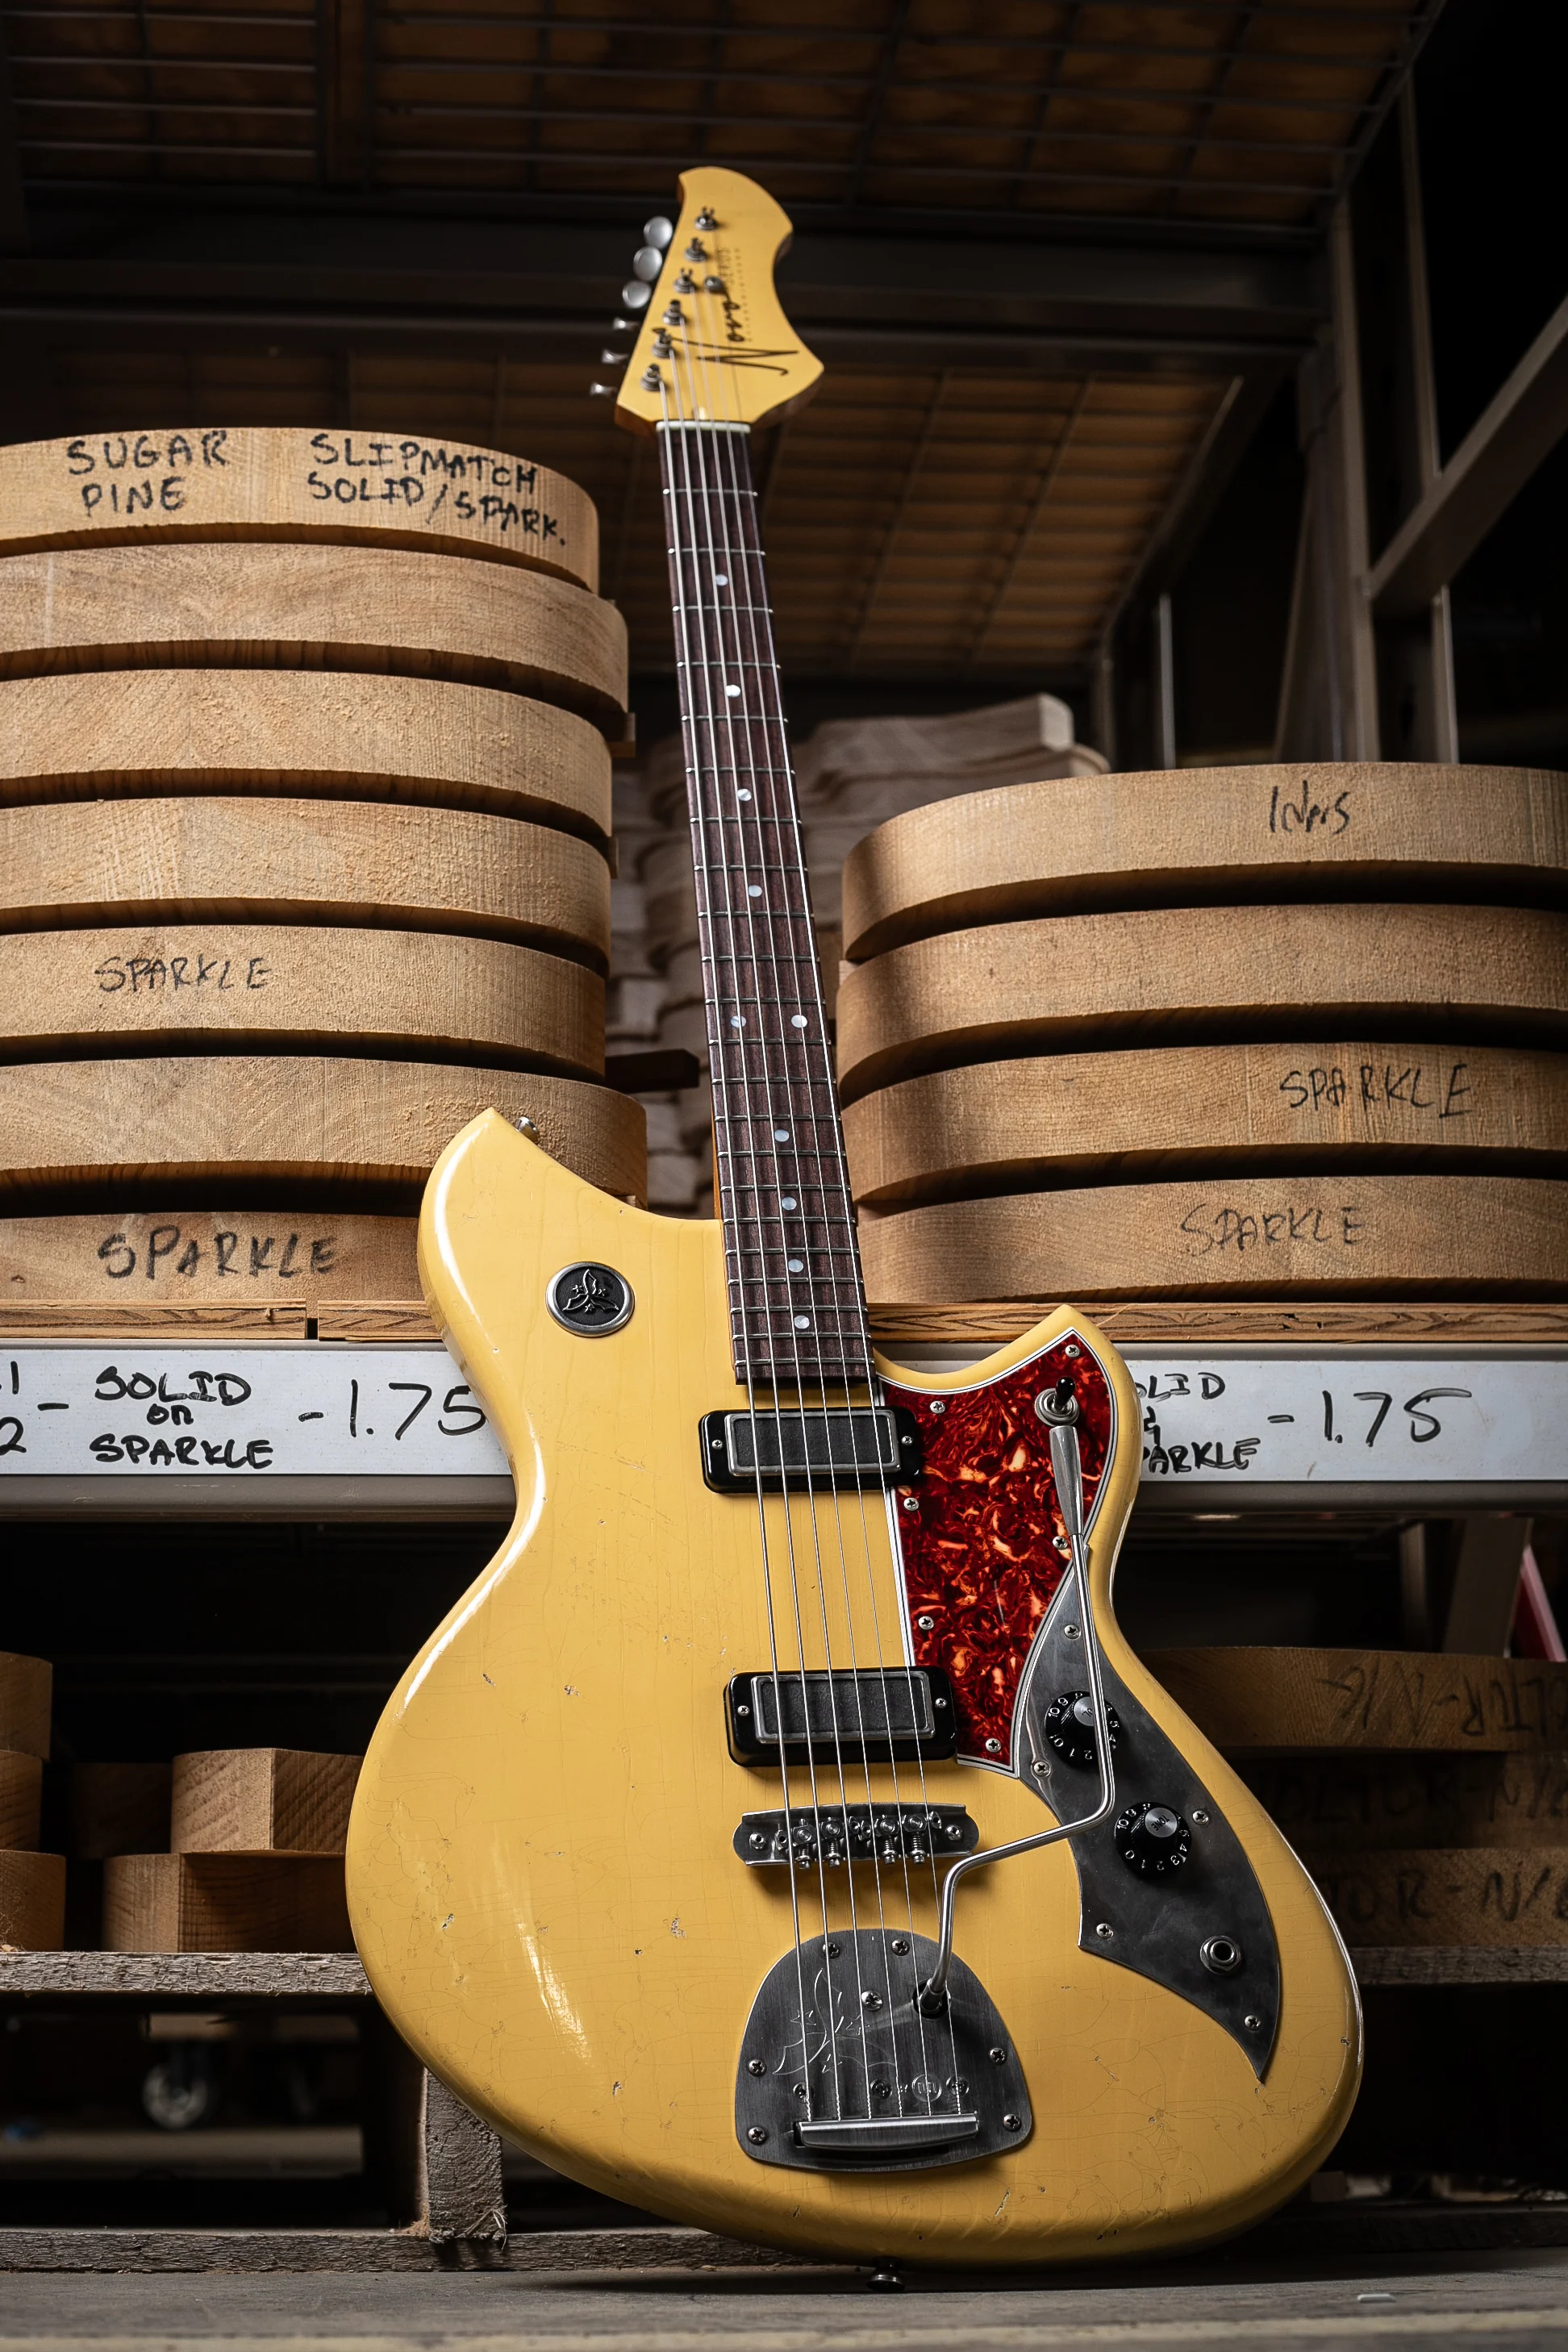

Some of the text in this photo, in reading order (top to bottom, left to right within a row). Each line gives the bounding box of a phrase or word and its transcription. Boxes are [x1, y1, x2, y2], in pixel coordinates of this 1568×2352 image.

[67, 430, 227, 475] SUGAR
[311, 433, 536, 494] SLIPMATCH
[82, 477, 186, 517] PINE
[94, 954, 272, 992] SPARKLE
[1280, 1063, 1474, 1119] SPARKLE
[1181, 1203, 1366, 1257] SPARKLE
[98, 1224, 339, 1281] SPARKLE
[0, 1361, 19, 1395] 1
[94, 1366, 252, 1406] SOLID
[89, 1432, 273, 1470] SPARKLE
[1048, 1707, 1061, 1718] 10
[1057, 1697, 1069, 1706] 9
[1150, 1814, 1170, 1832] TONE
